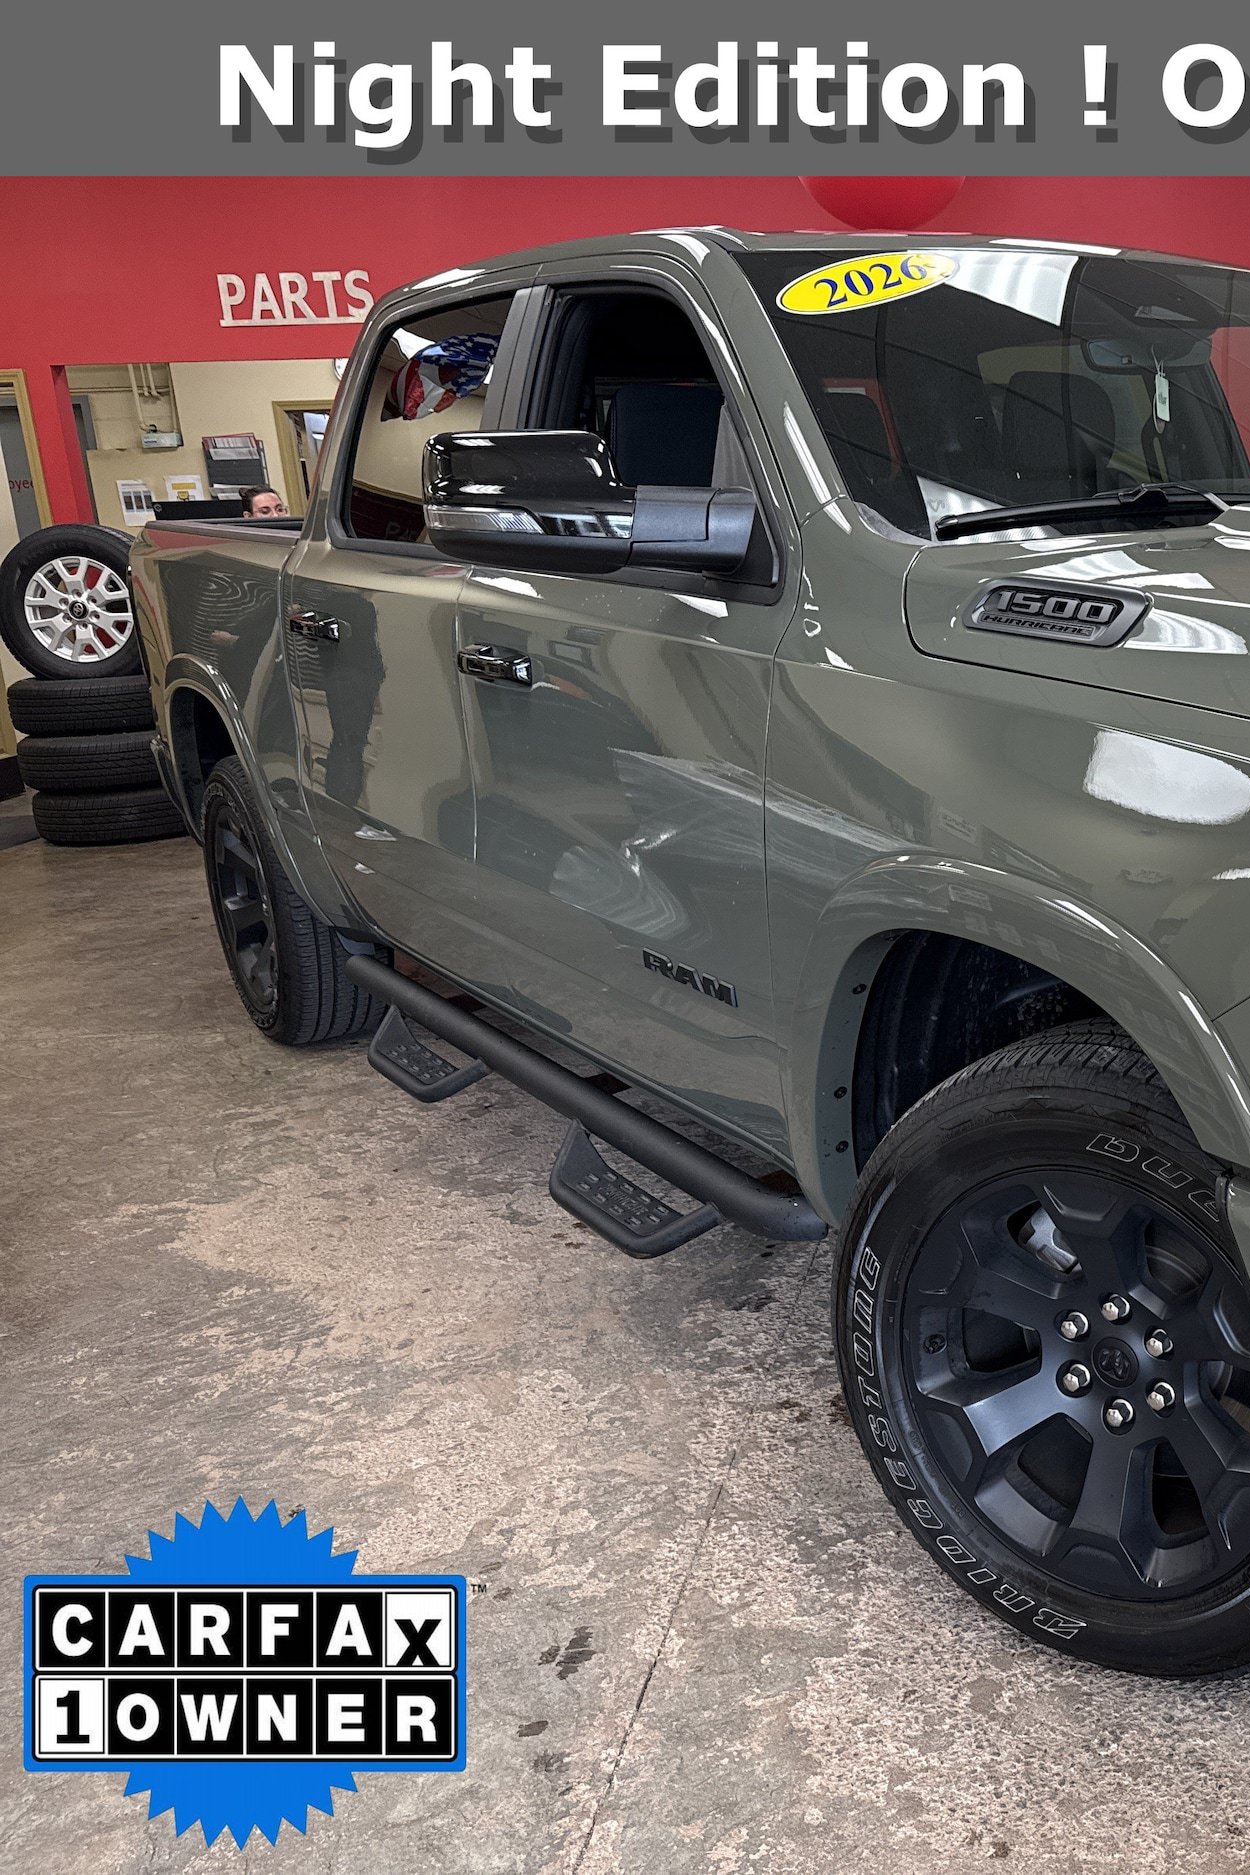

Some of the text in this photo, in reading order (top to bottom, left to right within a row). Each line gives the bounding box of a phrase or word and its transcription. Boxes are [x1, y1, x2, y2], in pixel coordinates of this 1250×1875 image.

[217, 269, 375, 327] PARTS
[814, 255, 928, 308] 2026
[982, 613, 1092, 637] HURRICANE
[997, 590, 1117, 624] 1500
[642, 947, 739, 1008] RAM
[853, 1247, 1087, 1639] BRIDGESTONE
